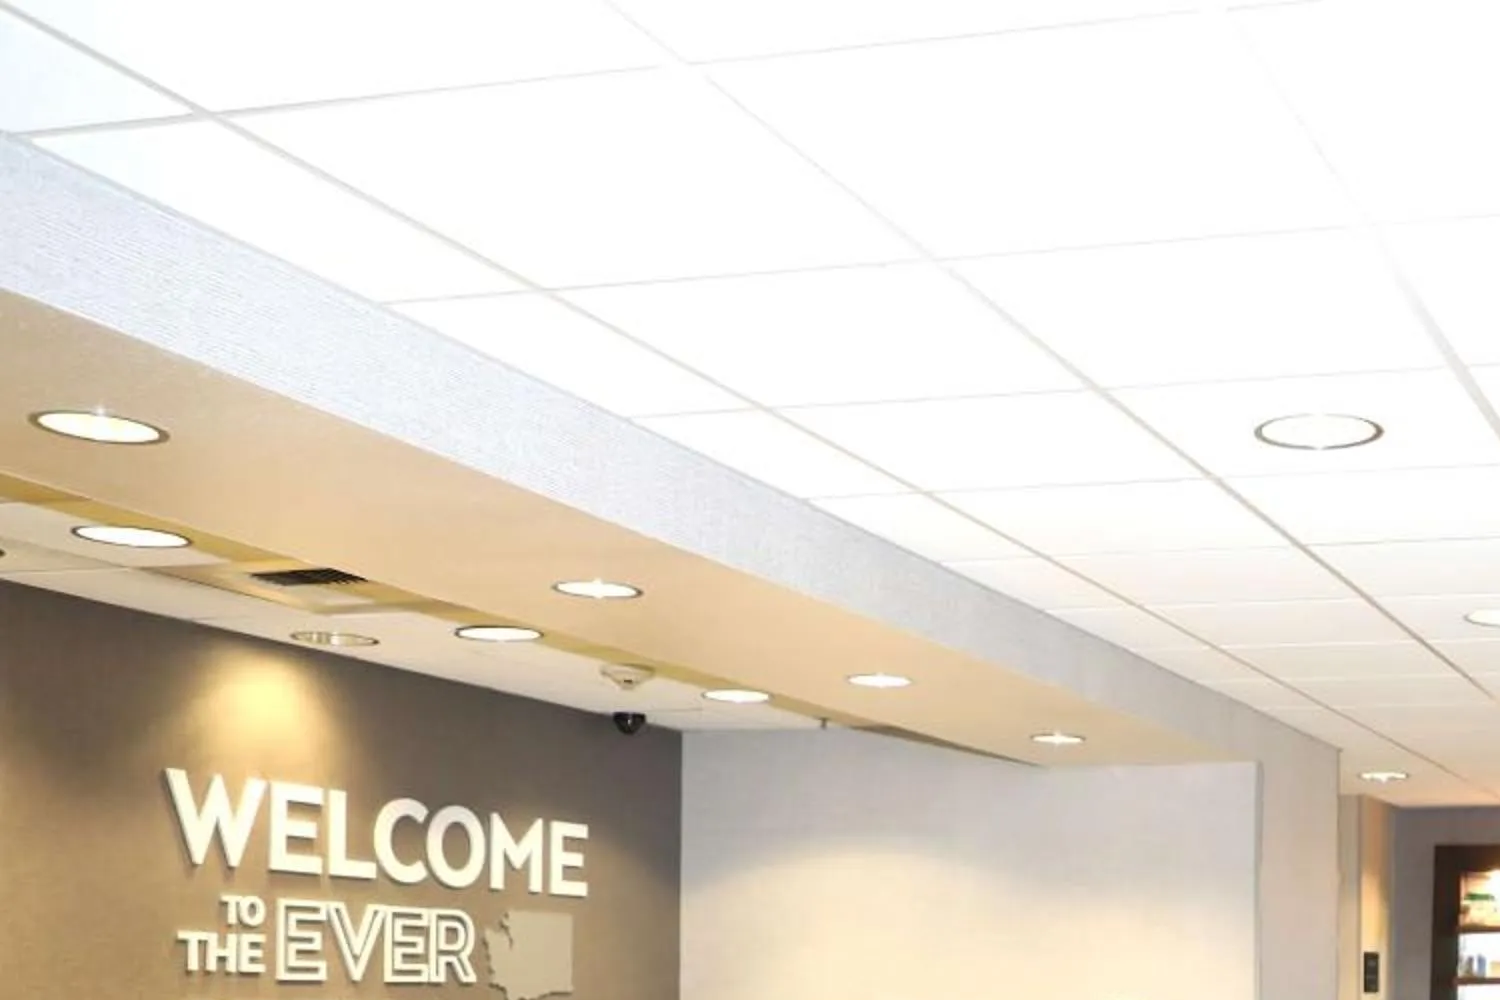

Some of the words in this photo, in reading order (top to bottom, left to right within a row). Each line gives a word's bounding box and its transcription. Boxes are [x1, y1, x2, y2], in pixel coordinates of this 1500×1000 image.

[164, 767, 589, 898] WELCOME
[176, 930, 267, 974] THE
[275, 898, 478, 984] EVER
[220, 895, 267, 927] TO
